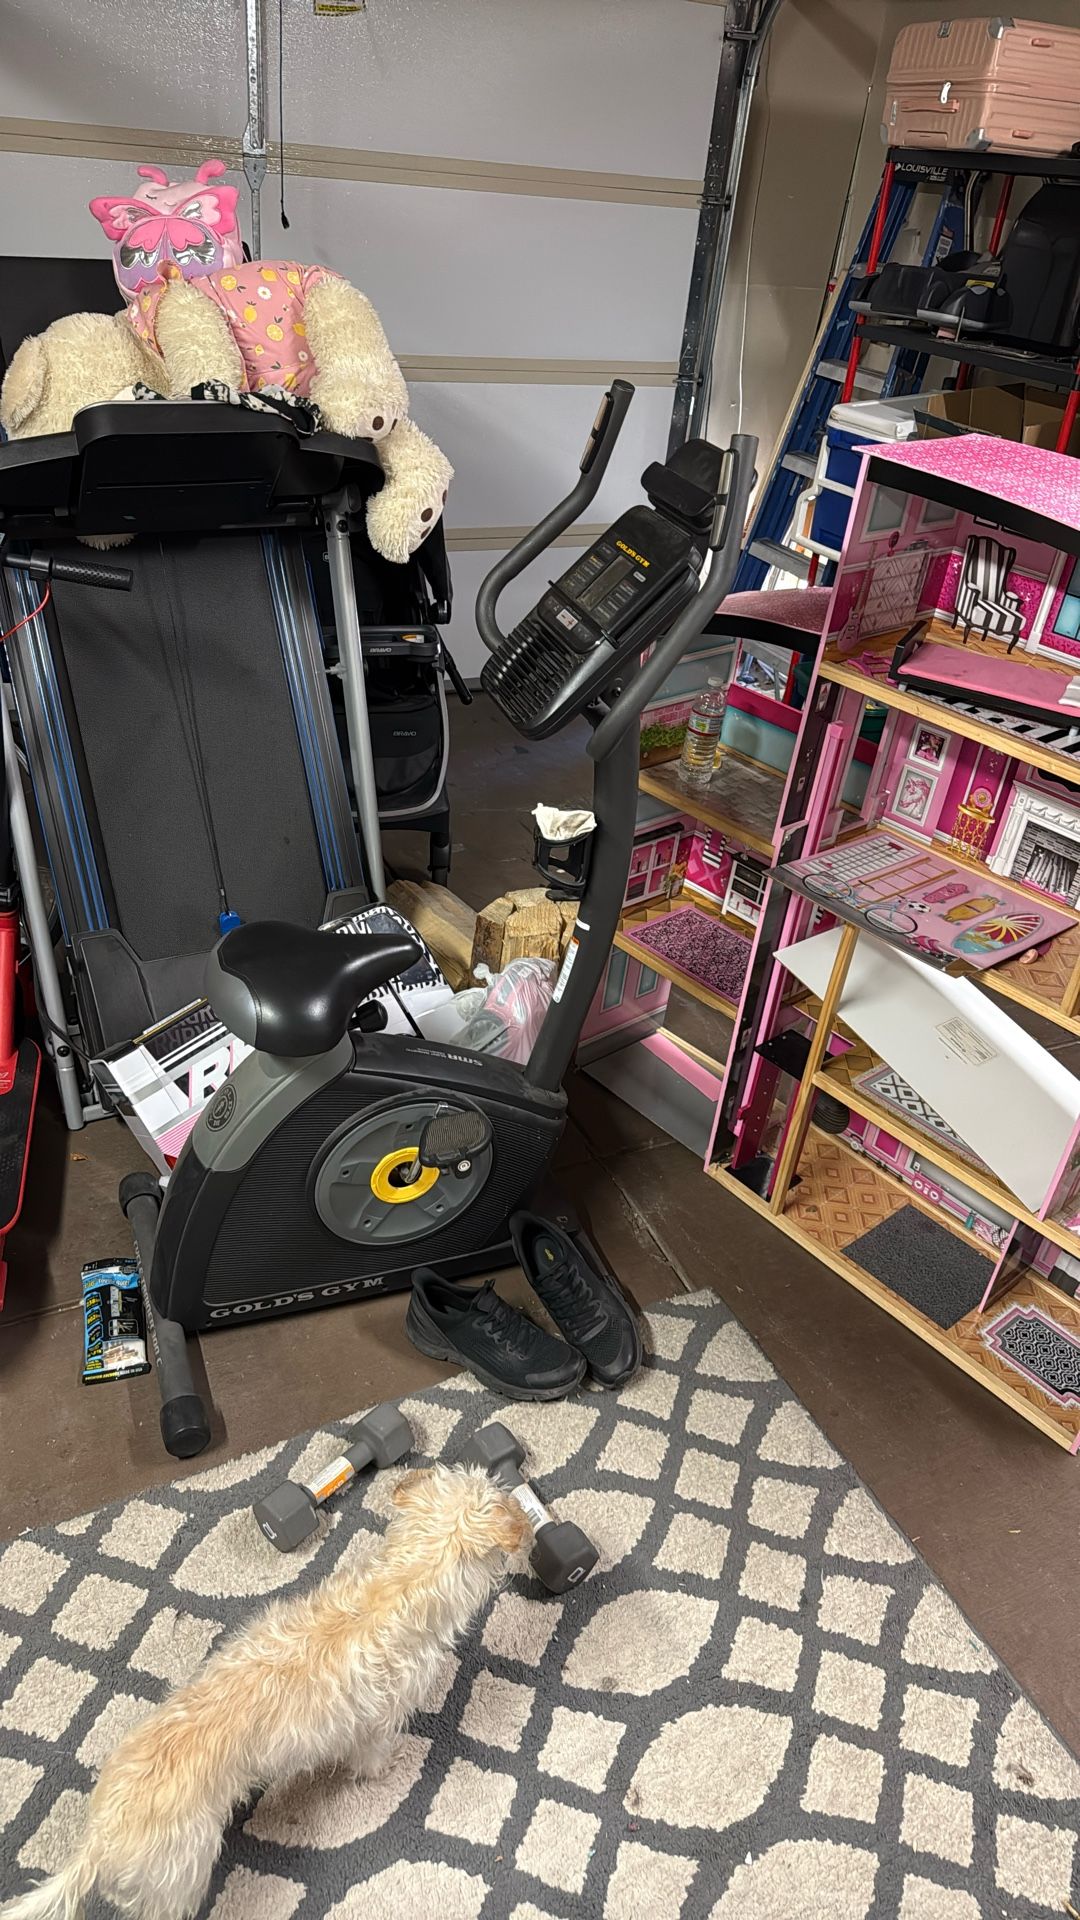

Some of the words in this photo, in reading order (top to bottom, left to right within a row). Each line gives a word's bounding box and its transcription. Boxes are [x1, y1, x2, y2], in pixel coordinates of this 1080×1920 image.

[900, 163, 949, 176] LOUISVILLE
[616, 540, 638, 558] GOLD'S
[635, 554, 651, 568] GYM
[209, 1291, 315, 1319] GOLD'S
[321, 1276, 384, 1297] GYM
